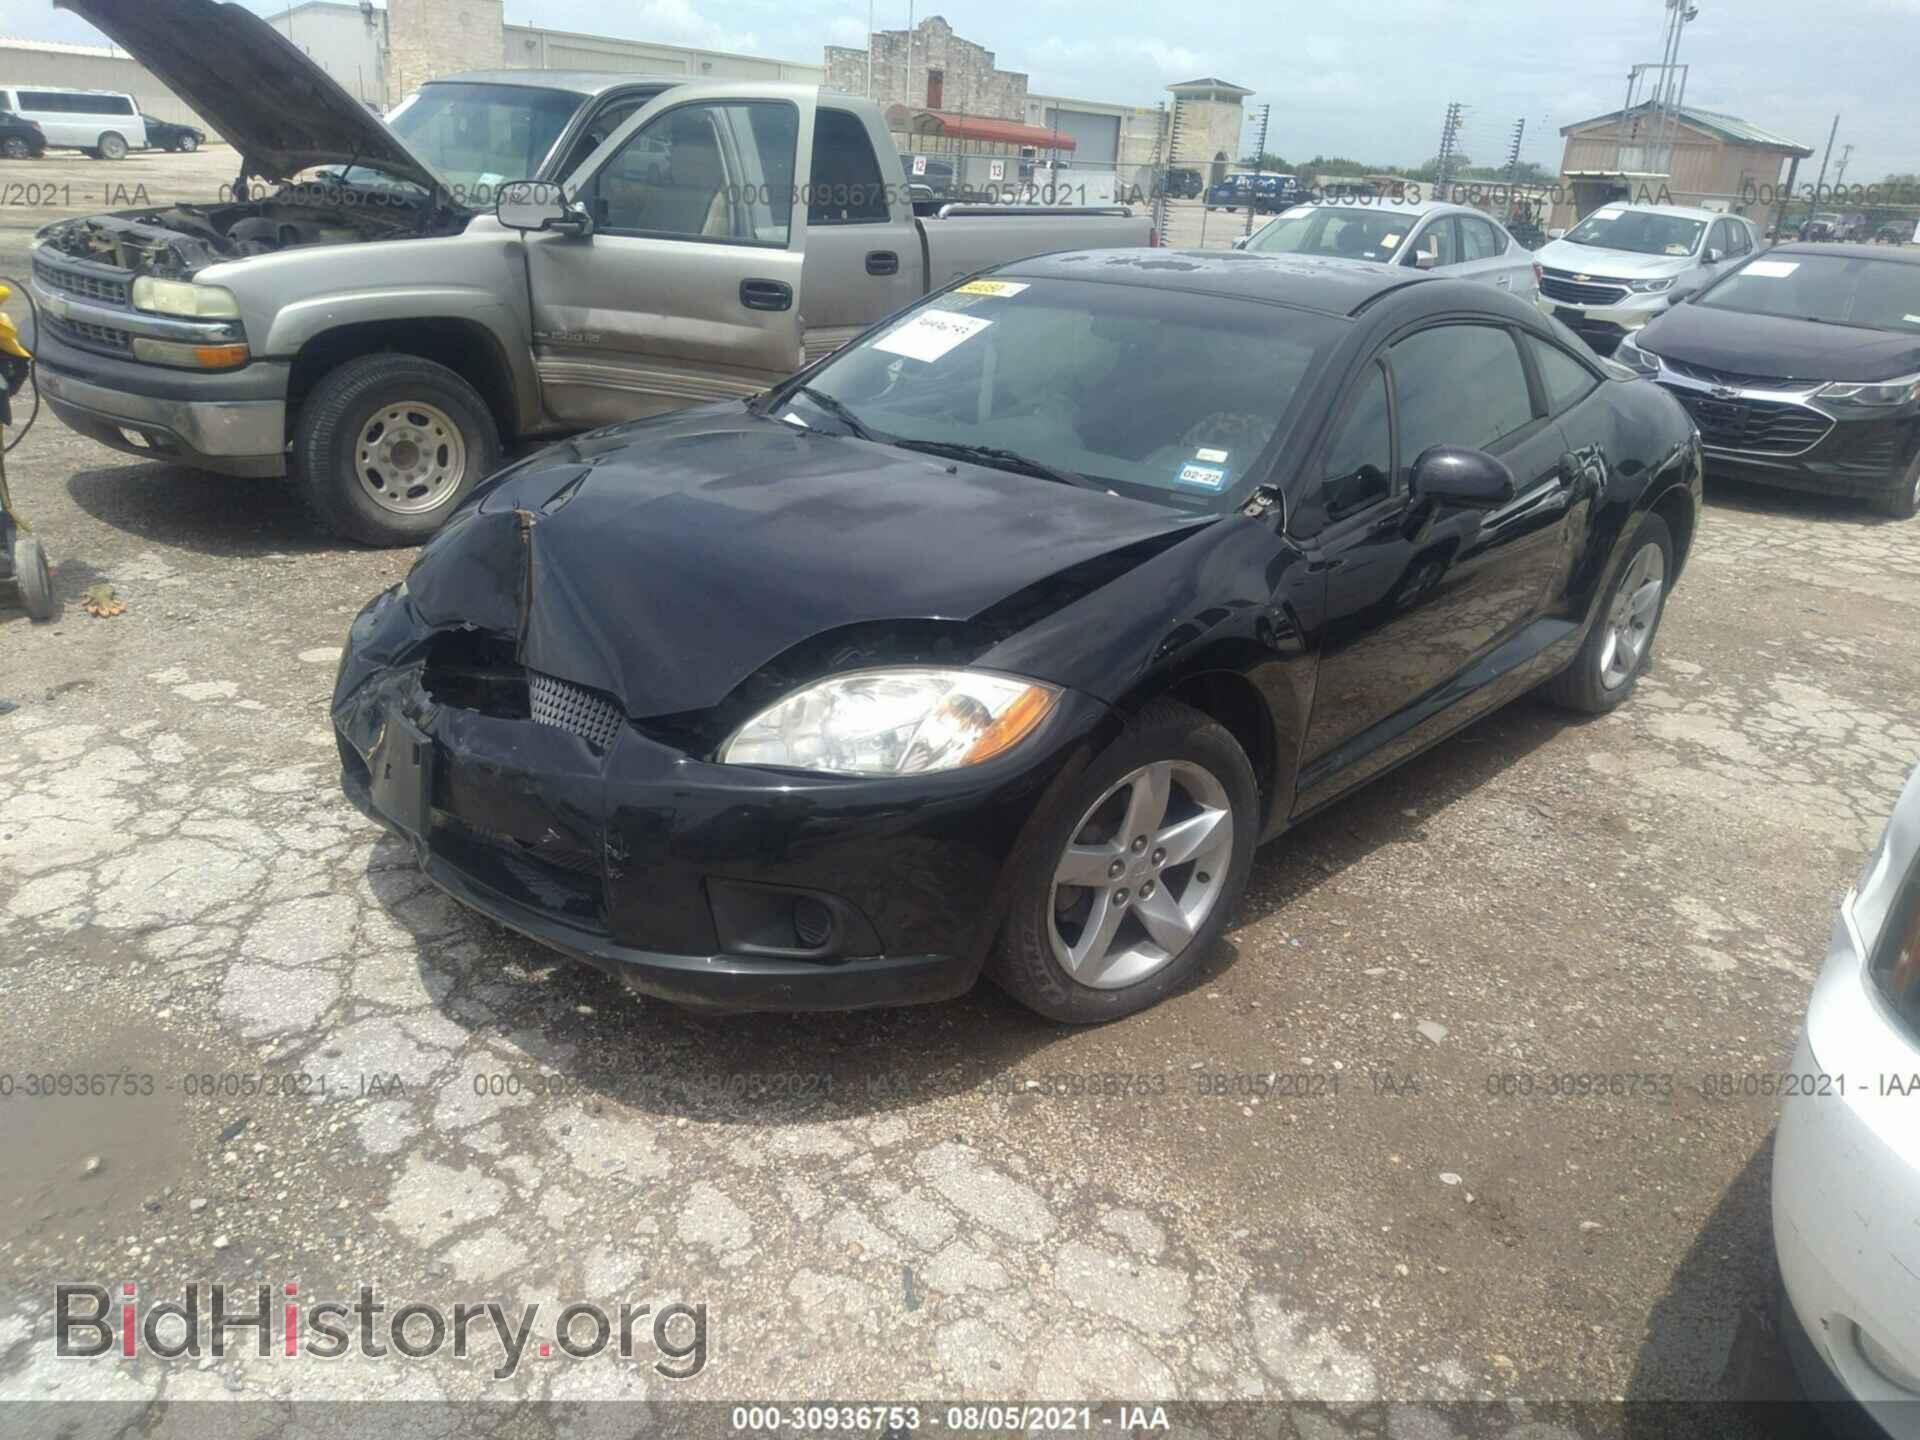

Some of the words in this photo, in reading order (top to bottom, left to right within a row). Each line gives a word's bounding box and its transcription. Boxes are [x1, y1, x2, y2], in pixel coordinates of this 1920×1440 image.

[914, 161, 925, 172] 12
[991, 165, 1002, 177] 13
[1183, 469, 1219, 482] 02-22
